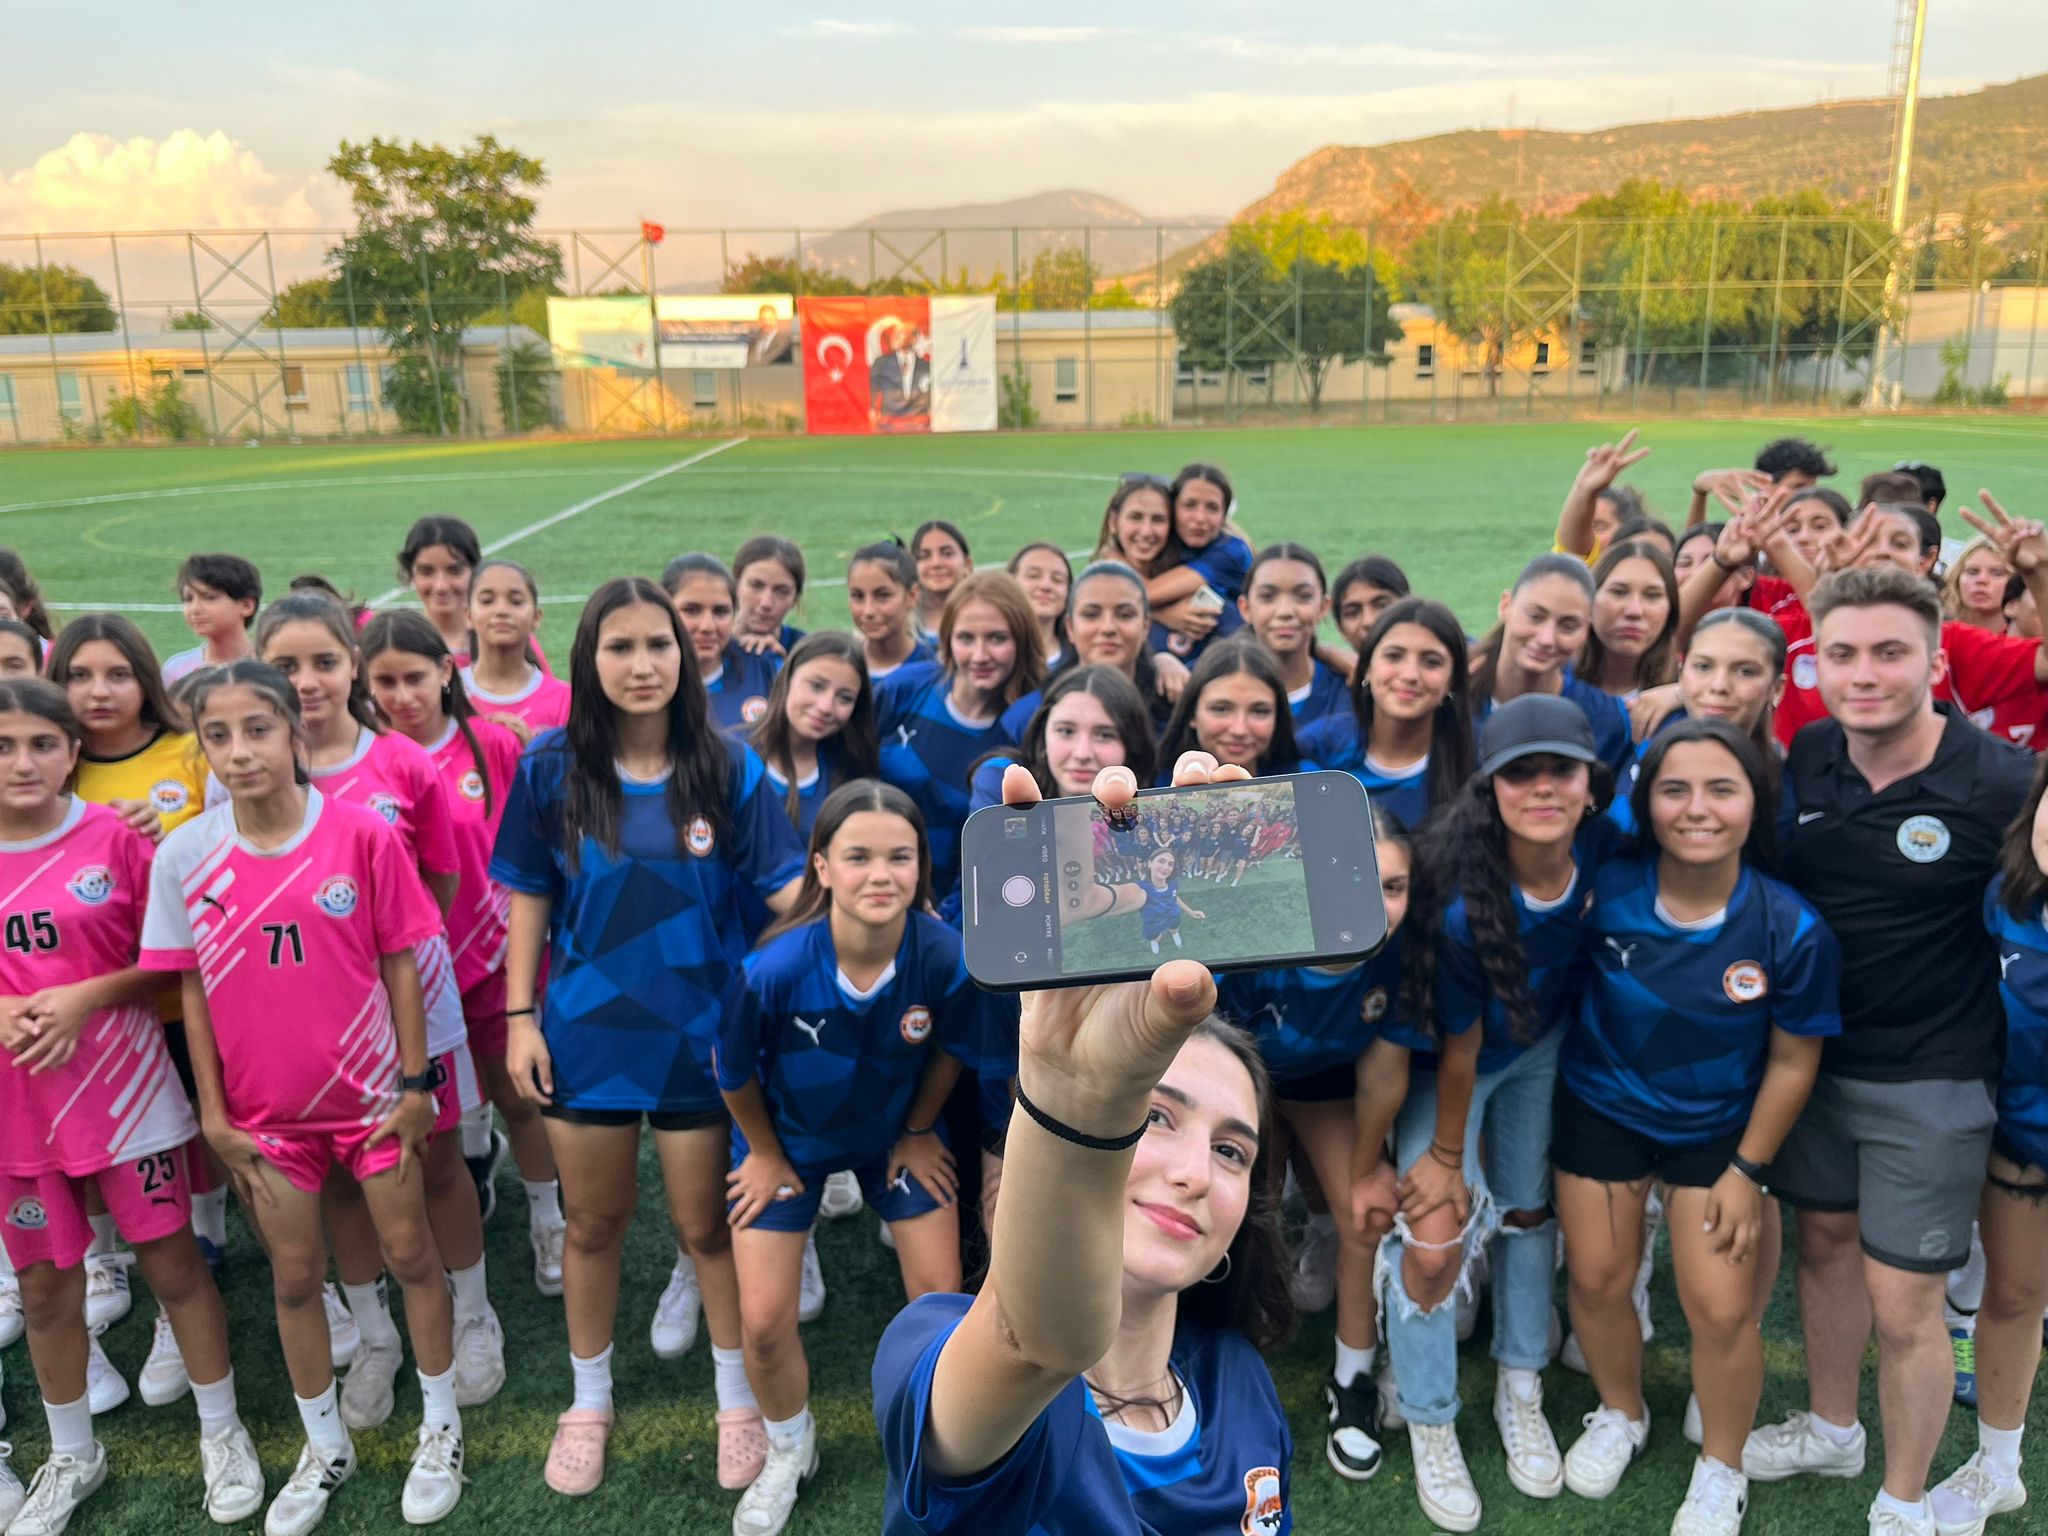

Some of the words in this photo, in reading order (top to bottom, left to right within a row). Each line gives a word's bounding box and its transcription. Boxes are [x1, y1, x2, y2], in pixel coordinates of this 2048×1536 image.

[5, 910, 60, 954] 45
[261, 923, 305, 965] 71
[137, 1152, 176, 1194] 25
